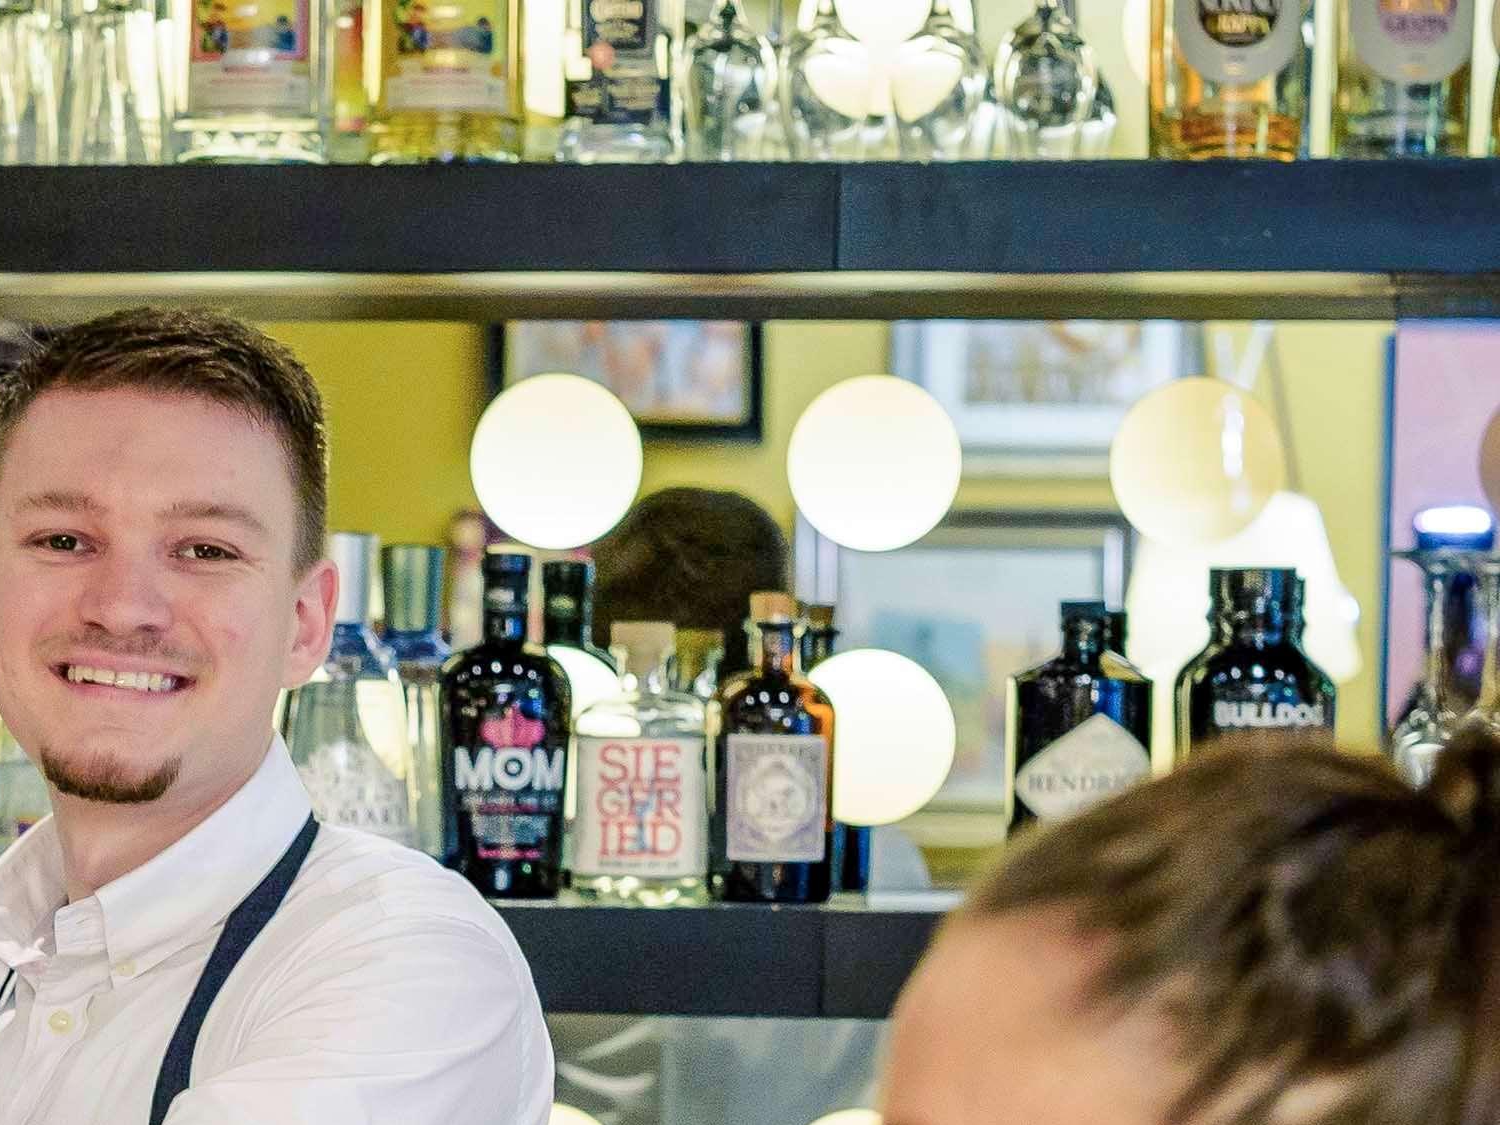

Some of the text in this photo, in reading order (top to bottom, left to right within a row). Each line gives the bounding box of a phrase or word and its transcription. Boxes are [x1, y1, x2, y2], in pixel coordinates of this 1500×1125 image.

[455, 746, 564, 791] MOM
[598, 743, 681, 784] SIE
[598, 818, 682, 856] IED
